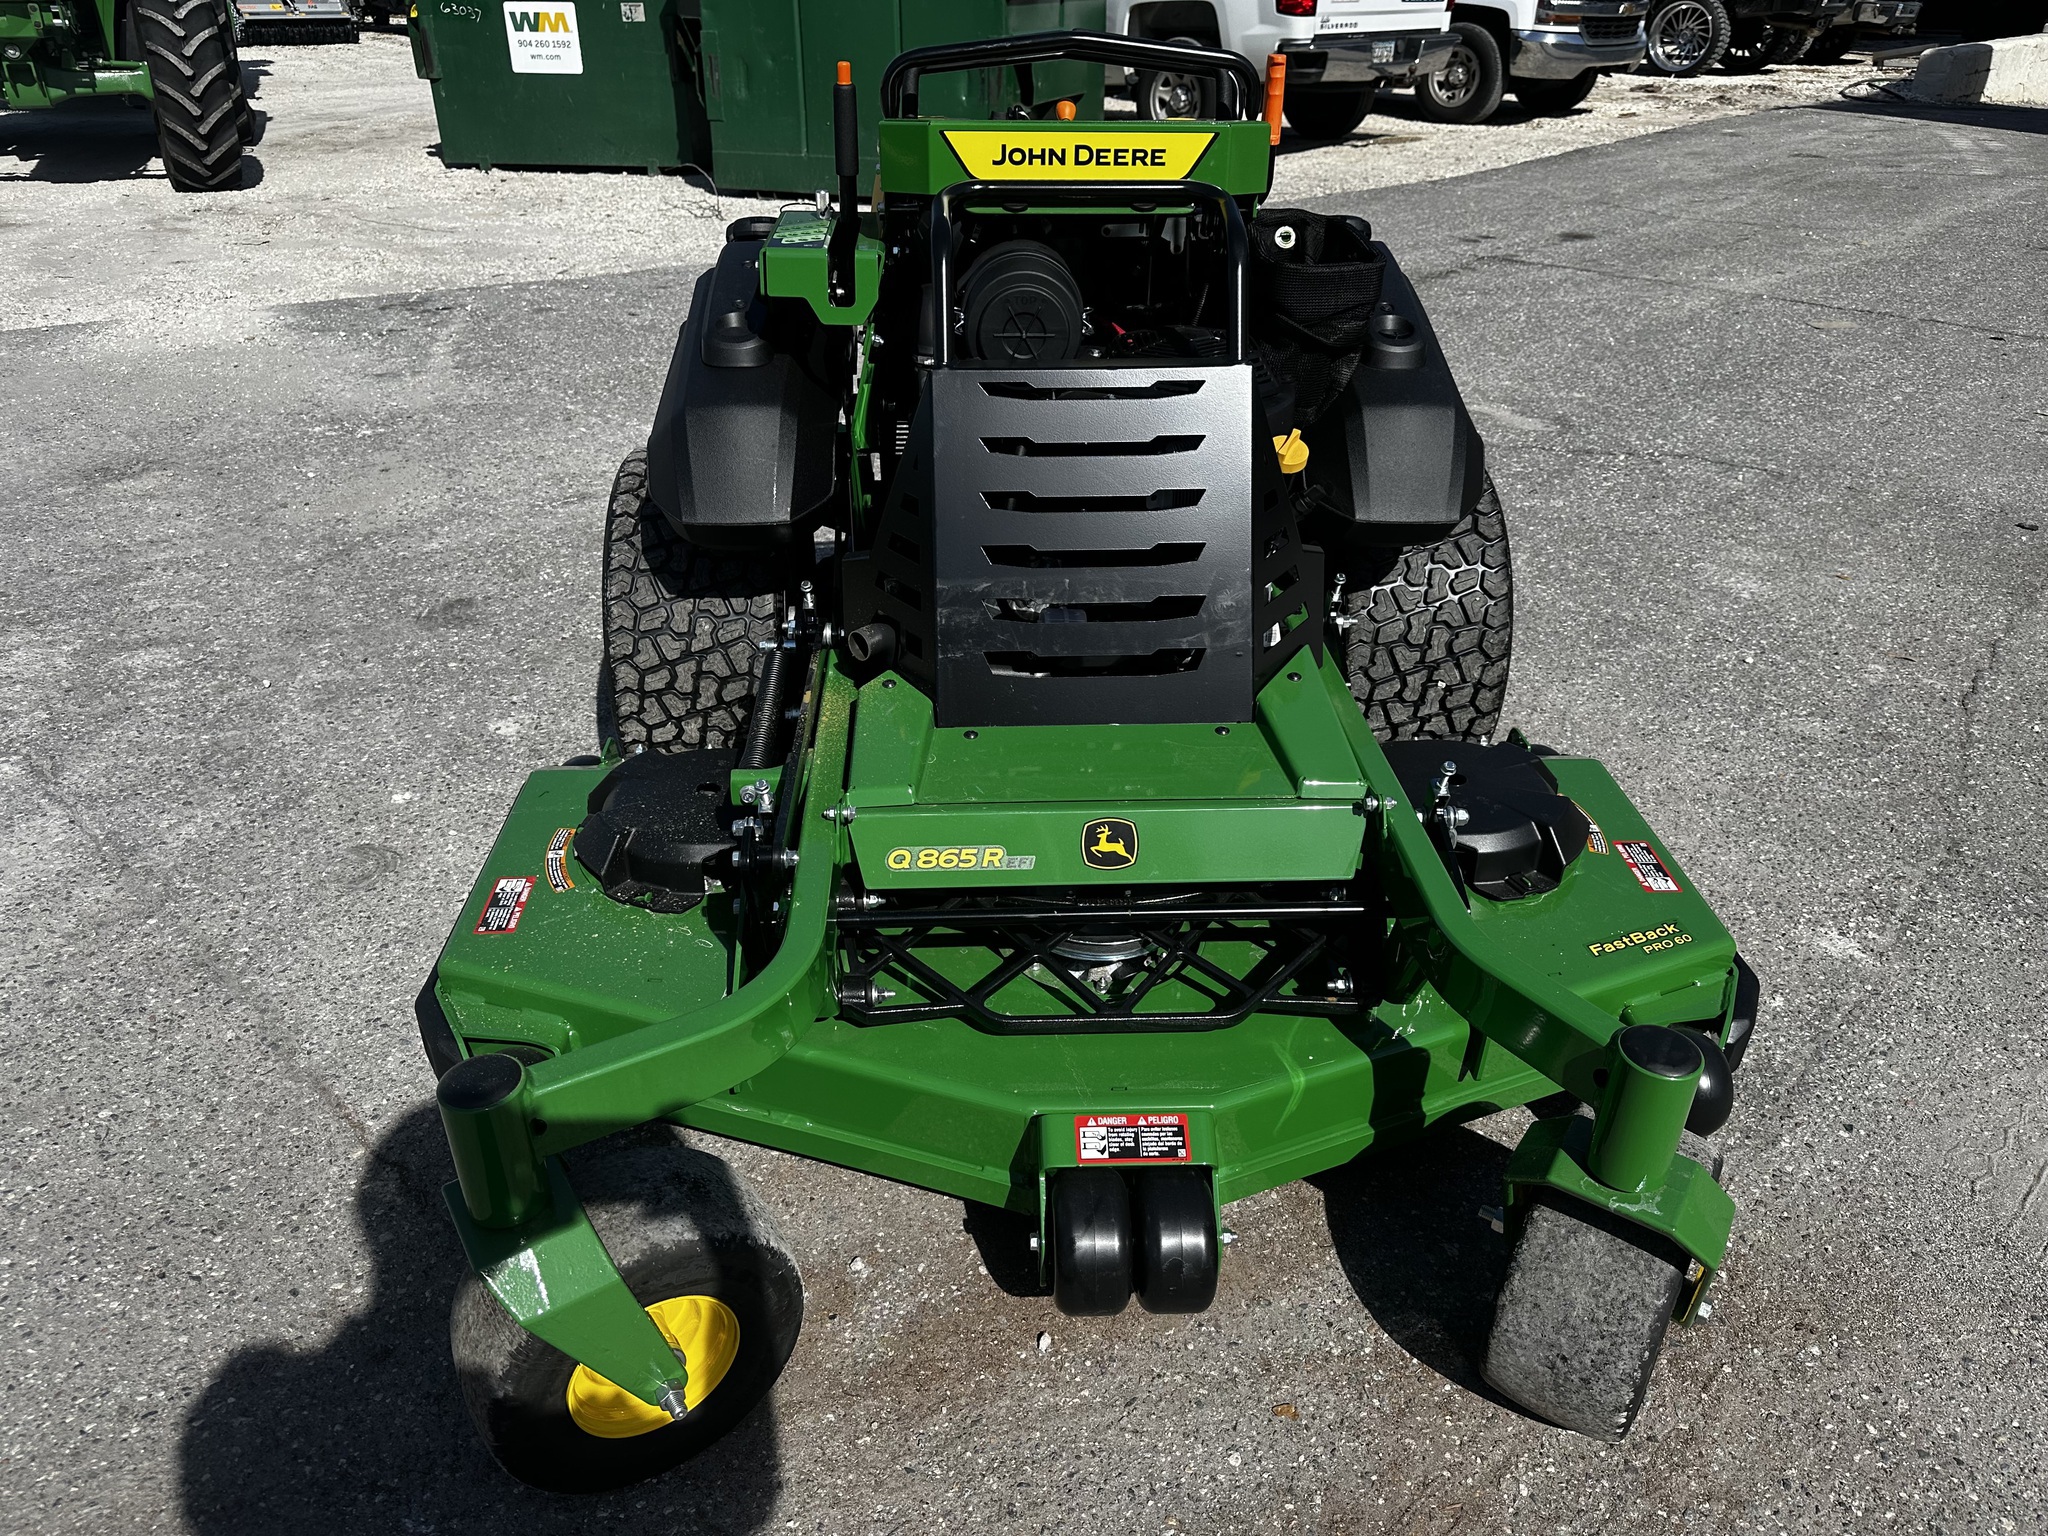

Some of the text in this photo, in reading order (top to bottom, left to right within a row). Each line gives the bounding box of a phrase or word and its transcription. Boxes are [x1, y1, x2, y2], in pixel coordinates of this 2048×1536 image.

[440, 2, 482, 23] 63037
[509, 11, 570, 33] WM
[517, 39, 571, 49] 904 260 1592
[530, 53, 561, 61] wm.com
[992, 144, 1166, 167] JOHN DEERE
[887, 848, 1034, 869] Q 865 R EFI
[1588, 923, 1680, 956] FastBack
[1643, 934, 1692, 954] PRO 60
[1097, 1117, 1127, 1125] DANGER
[1148, 1116, 1179, 1124] PELIGRO
